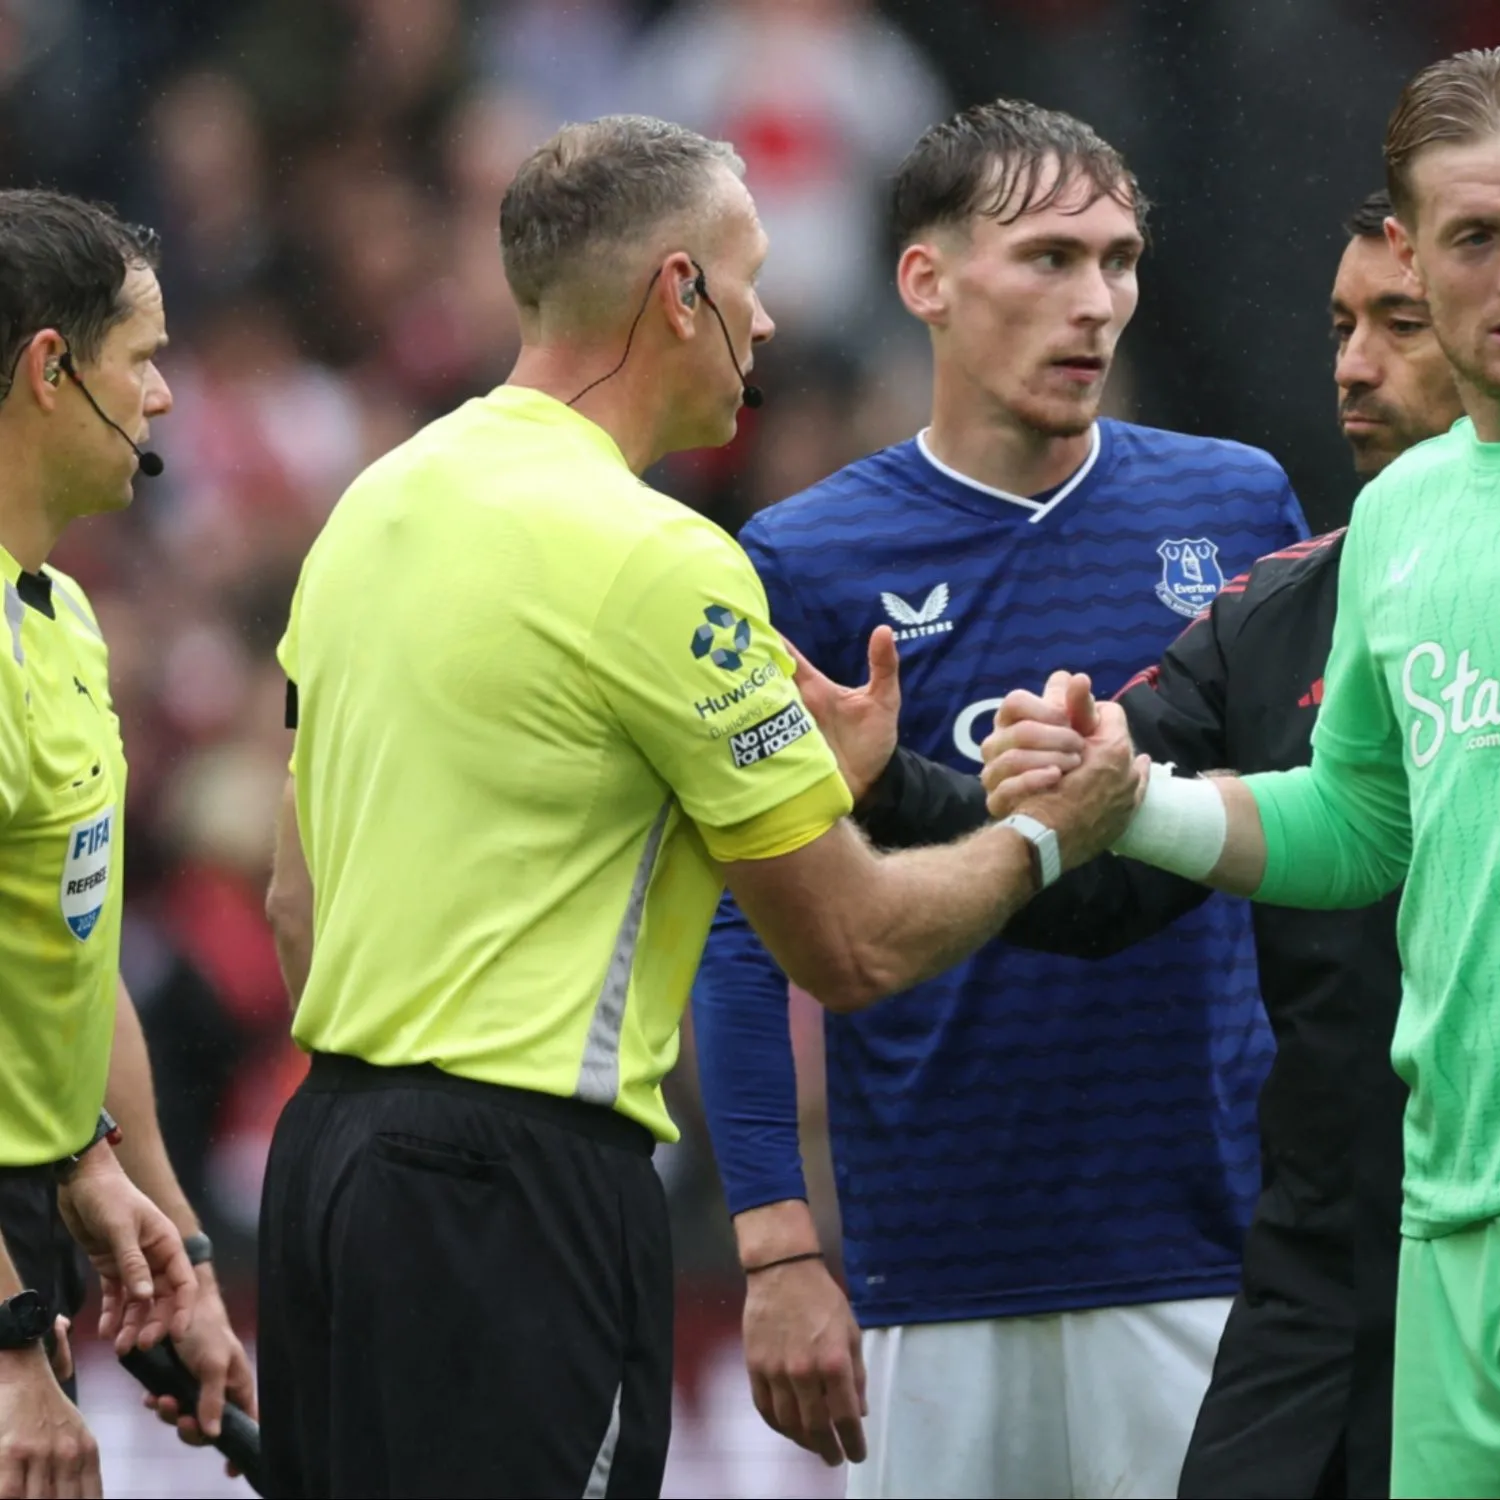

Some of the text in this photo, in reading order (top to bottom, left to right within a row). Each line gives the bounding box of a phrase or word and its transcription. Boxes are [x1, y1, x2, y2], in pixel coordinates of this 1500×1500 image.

[891, 621, 954, 642] CASTORE
[730, 703, 804, 754] No room
[735, 718, 812, 768] for racism
[73, 816, 111, 860] FIFA
[66, 865, 108, 896] REFEREE
